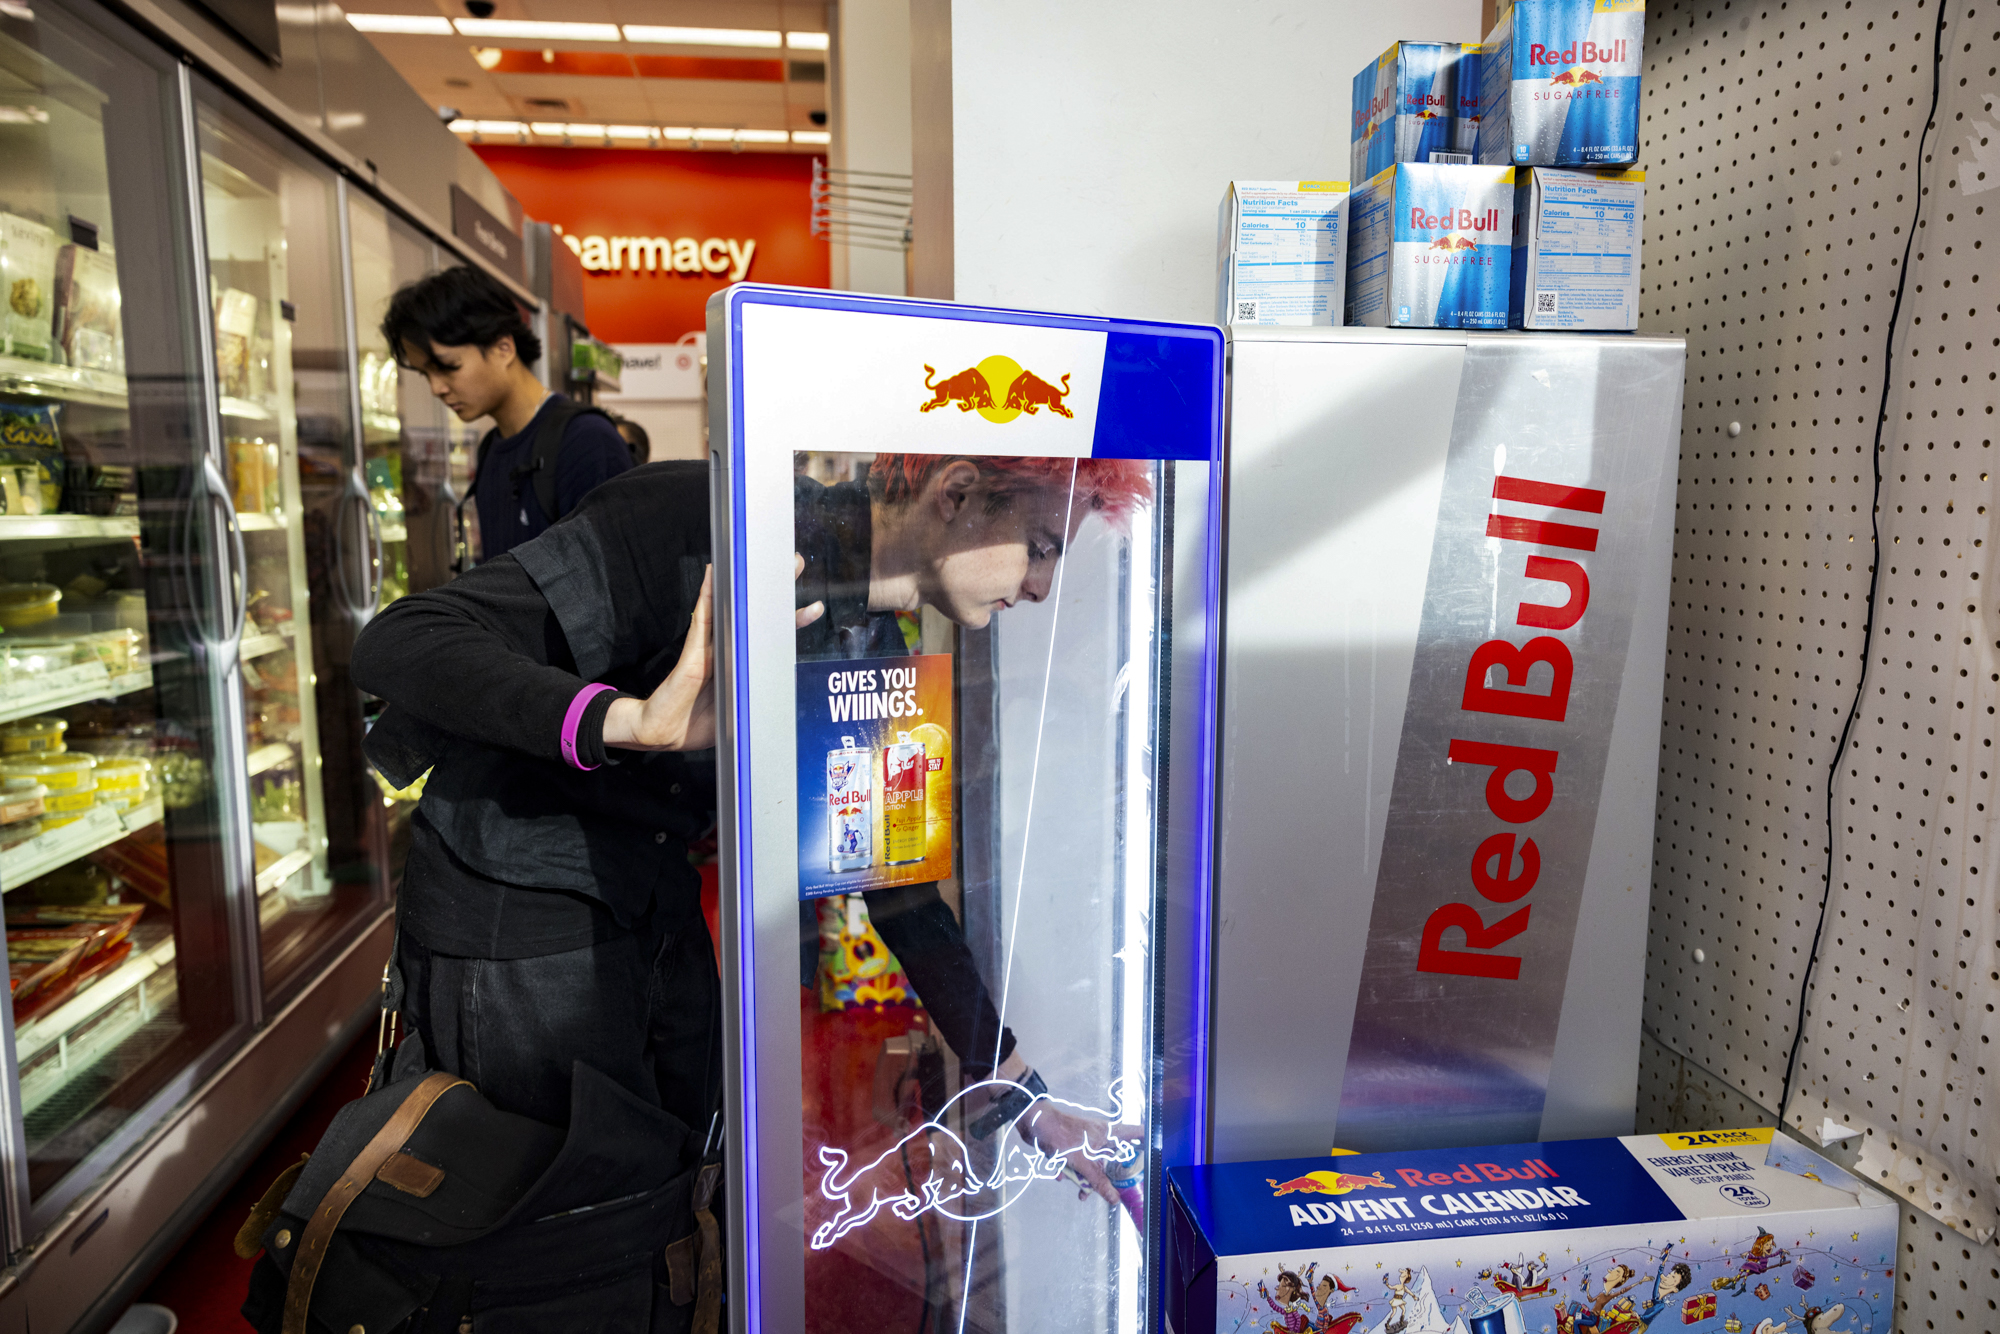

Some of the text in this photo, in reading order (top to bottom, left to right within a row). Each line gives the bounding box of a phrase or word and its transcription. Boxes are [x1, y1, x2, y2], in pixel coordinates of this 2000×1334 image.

[1530, 39, 1626, 66] Red Bull
[1407, 94, 1445, 106] Red Bull
[1461, 96, 1478, 107] Red
[1534, 90, 1620, 100] SUGARFREE
[1355, 87, 1389, 130] Red Bull
[1356, 132, 1386, 159] SUGARFREE
[1411, 208, 1454, 230] Red
[1458, 209, 1498, 231] Bull
[552, 224, 756, 282] armacy
[1415, 255, 1492, 266] SUGARFREE
[1461, 476, 1606, 722] Bull
[828, 667, 916, 694] GIVES YOU
[828, 690, 924, 722] WIIINGS.
[830, 789, 871, 806] Red Bull
[885, 789, 923, 804] APPLE
[1416, 738, 1559, 980] Red
[1678, 1134, 1718, 1146] 24
[1647, 1152, 1743, 1168] ENERGY DRINK
[1662, 1161, 1756, 1178] VARIETY PACK
[1396, 1159, 1560, 1188] Red Bull
[1690, 1173, 1755, 1186] (SEE TOP PANEL)
[1724, 1186, 1754, 1197] 24
[1288, 1186, 1591, 1226] ADVENT CALENDAR
[1341, 1212, 1568, 1236] 24 8.4 FL OZ (250 mL) CANS (201.6 FL OZ/6.0 L)
